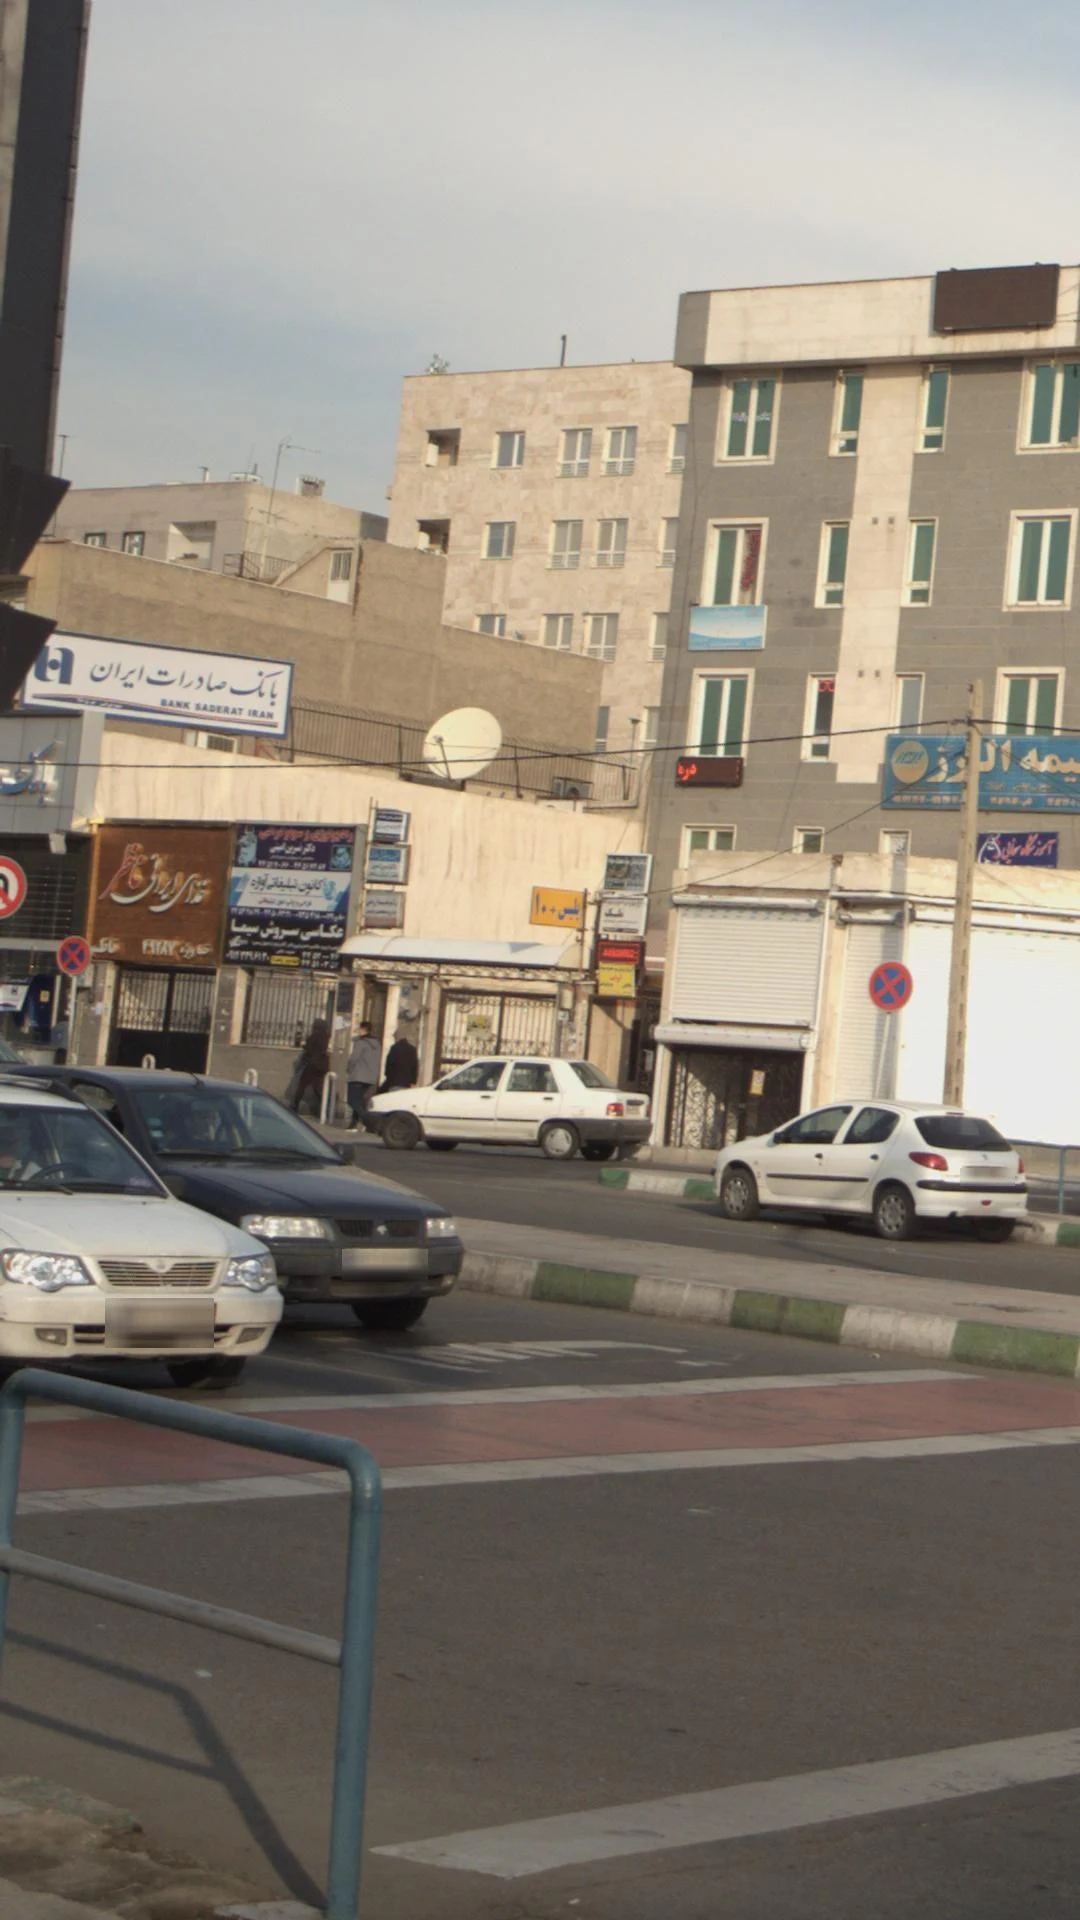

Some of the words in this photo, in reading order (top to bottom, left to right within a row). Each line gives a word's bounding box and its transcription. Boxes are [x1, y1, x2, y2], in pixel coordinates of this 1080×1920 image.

[89, 661, 144, 689] ایران
[146, 667, 228, 692] صادرات
[229, 669, 285, 706] بانک
[159, 698, 190, 711] BANK
[195, 701, 244, 717] SADERAT
[248, 708, 275, 720] IRAN
[926, 739, 1012, 783] الرز
[230, 917, 260, 937] سیما
[260, 919, 300, 941] سروش
[300, 923, 344, 942] عکاسی
